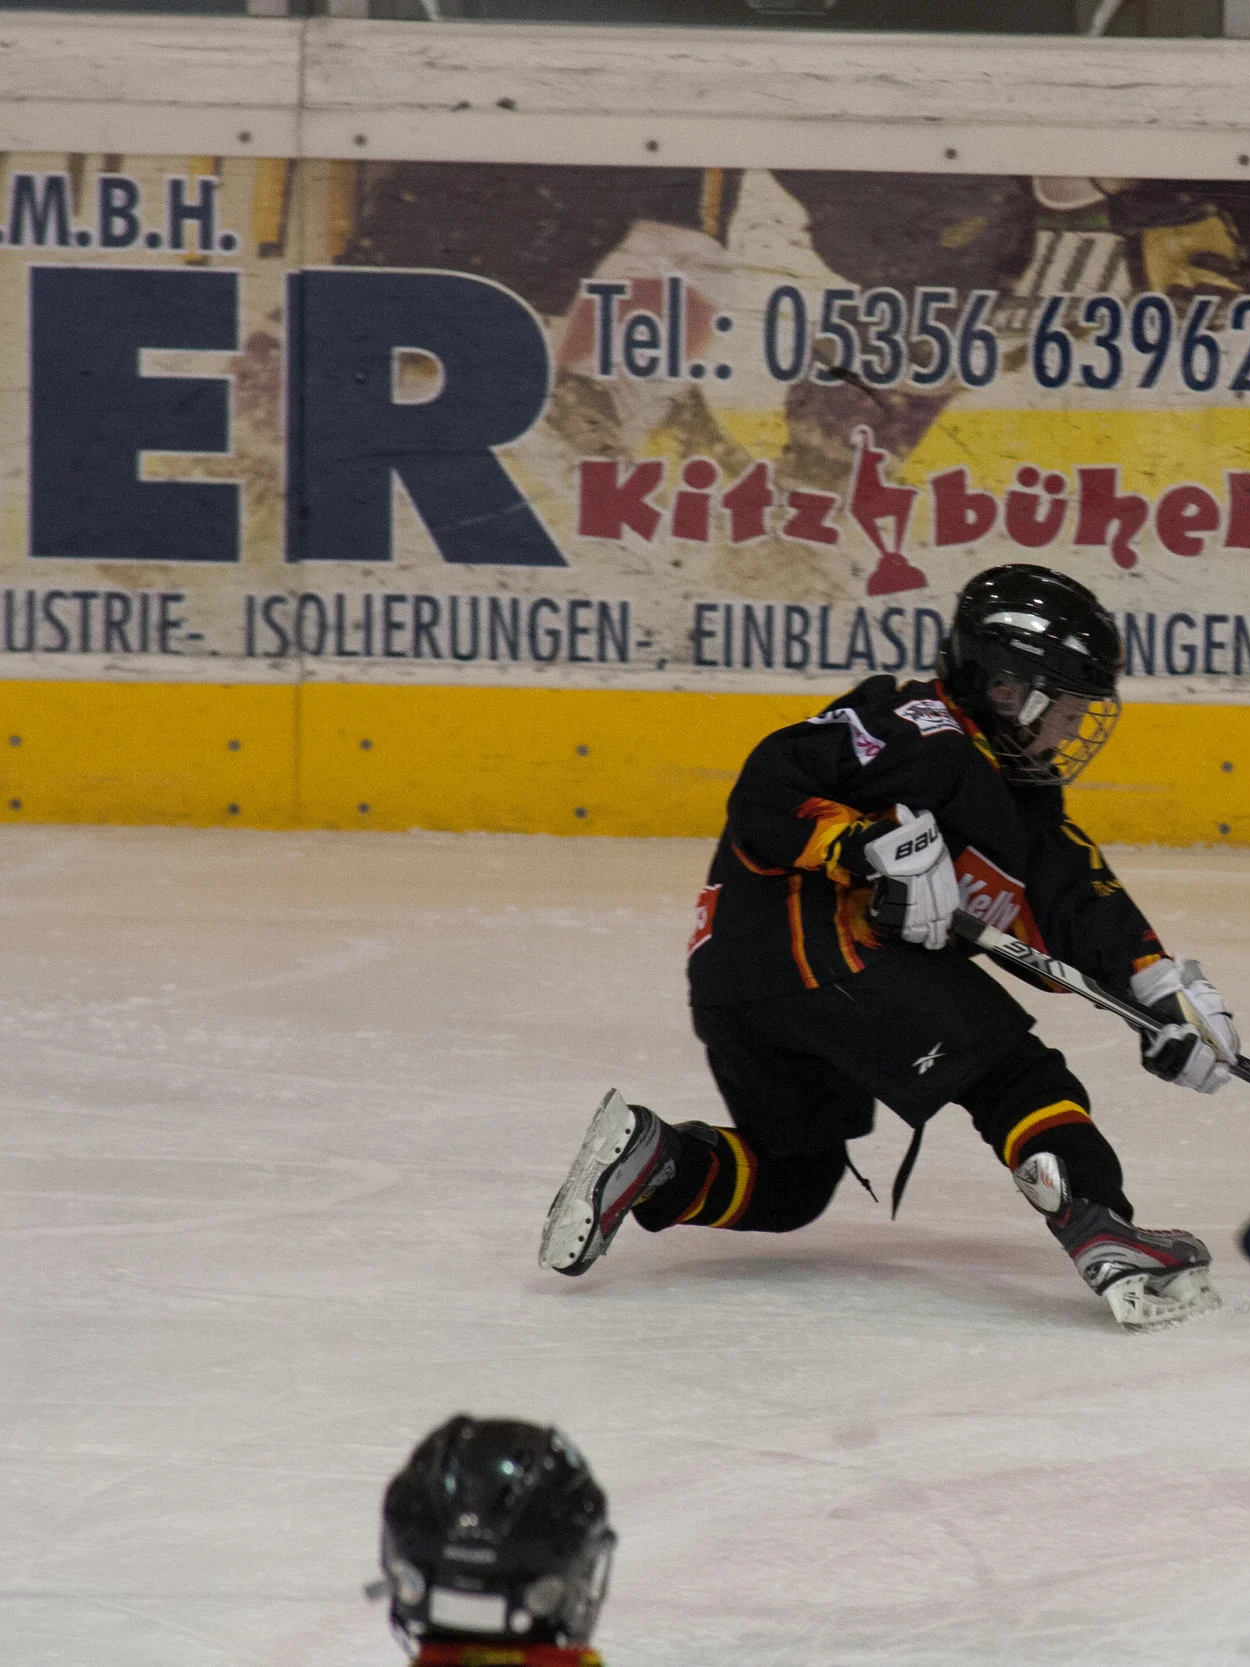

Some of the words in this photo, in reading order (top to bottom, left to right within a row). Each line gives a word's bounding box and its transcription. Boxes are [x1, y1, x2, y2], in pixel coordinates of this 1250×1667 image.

[0, 173, 237, 252] M.B.H.
[586, 276, 733, 380] Tel.:
[764, 284, 999, 387] 05356
[28, 267, 570, 567] ER
